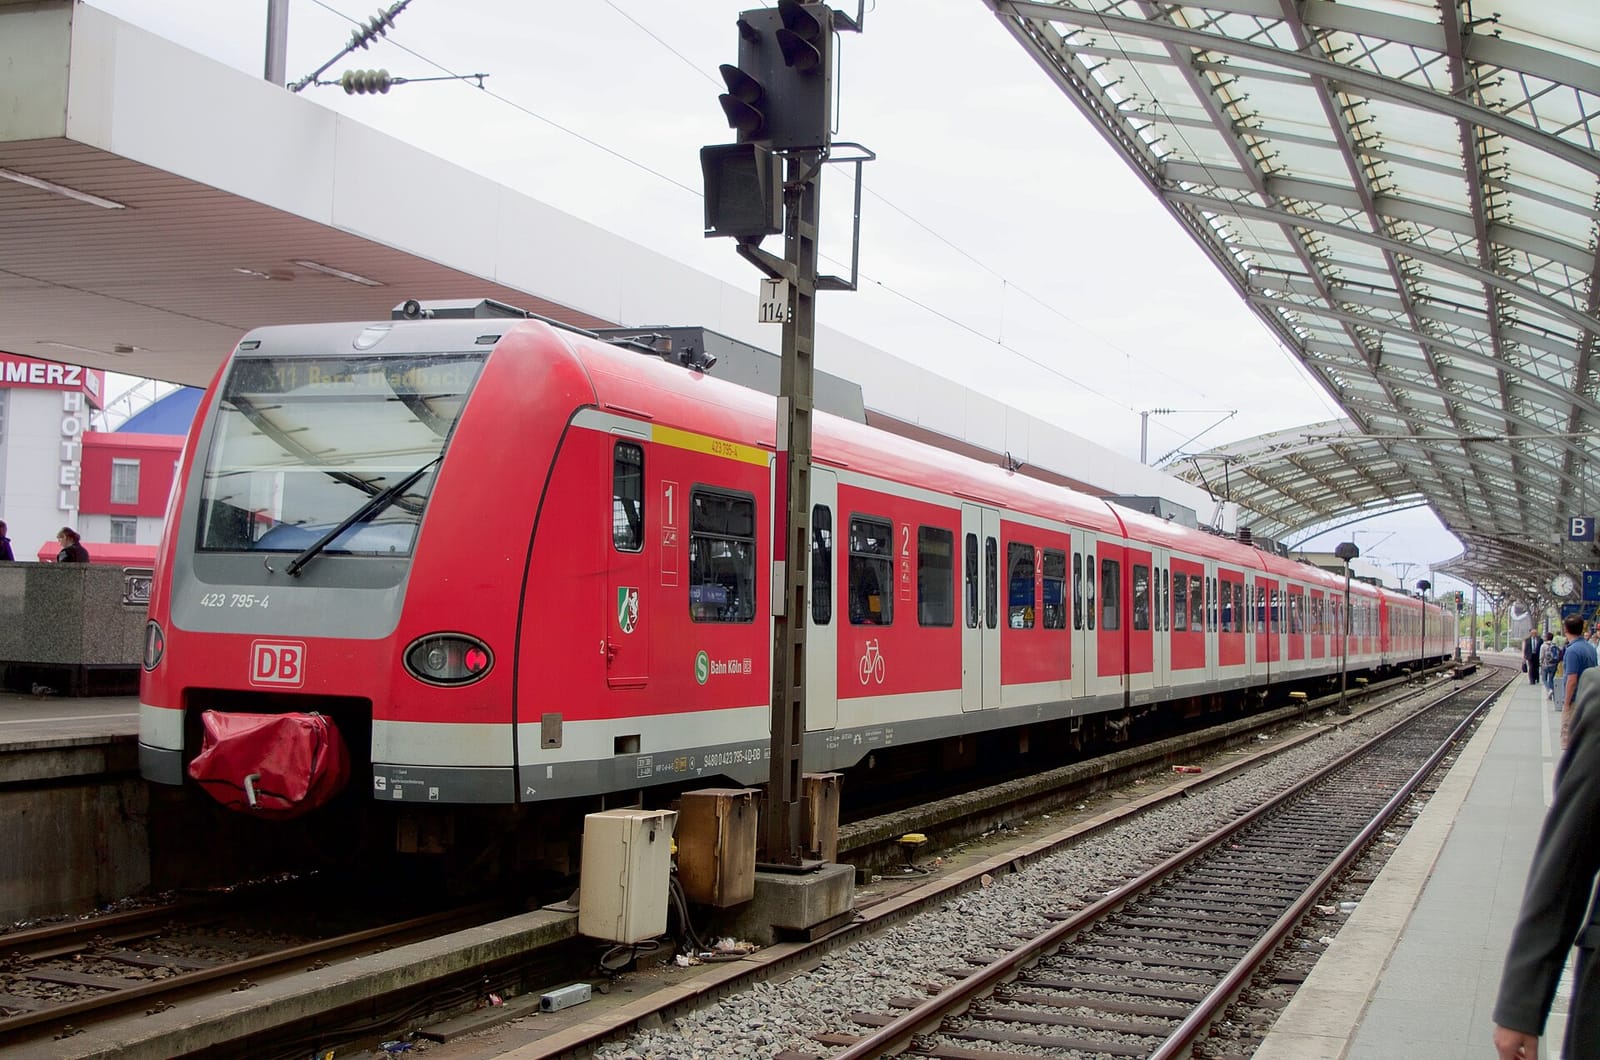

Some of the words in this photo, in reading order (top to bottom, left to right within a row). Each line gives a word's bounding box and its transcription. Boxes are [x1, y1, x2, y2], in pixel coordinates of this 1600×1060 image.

[768, 281, 781, 299] T
[762, 302, 784, 321] 114
[60, 391, 81, 510] HOTEL
[664, 485, 673, 525] 1
[1571, 517, 1586, 537] B
[902, 525, 910, 557] 2
[1036, 549, 1042, 573] 2
[200, 593, 227, 608] 423
[230, 594, 270, 609] 795-4
[254, 645, 302, 682] DB
[710, 659, 727, 675] Bahn
[728, 659, 742, 674] Köln
